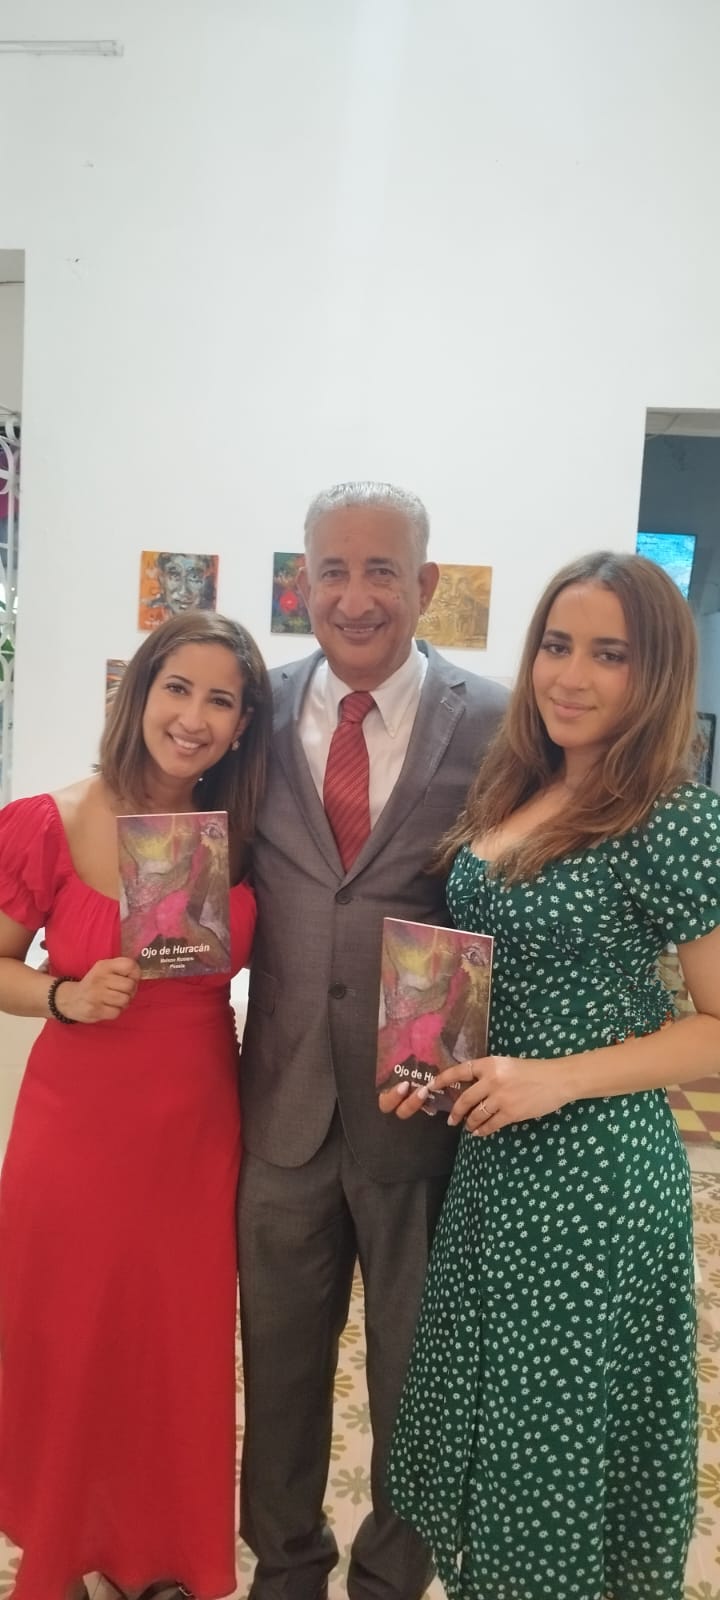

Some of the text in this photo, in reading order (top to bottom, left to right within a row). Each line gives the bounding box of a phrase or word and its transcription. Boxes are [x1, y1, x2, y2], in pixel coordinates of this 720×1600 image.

[141, 944, 210, 959] Ojo de Huracán
[394, 1064, 409, 1077] Ojo
[411, 1069, 422, 1080] de
